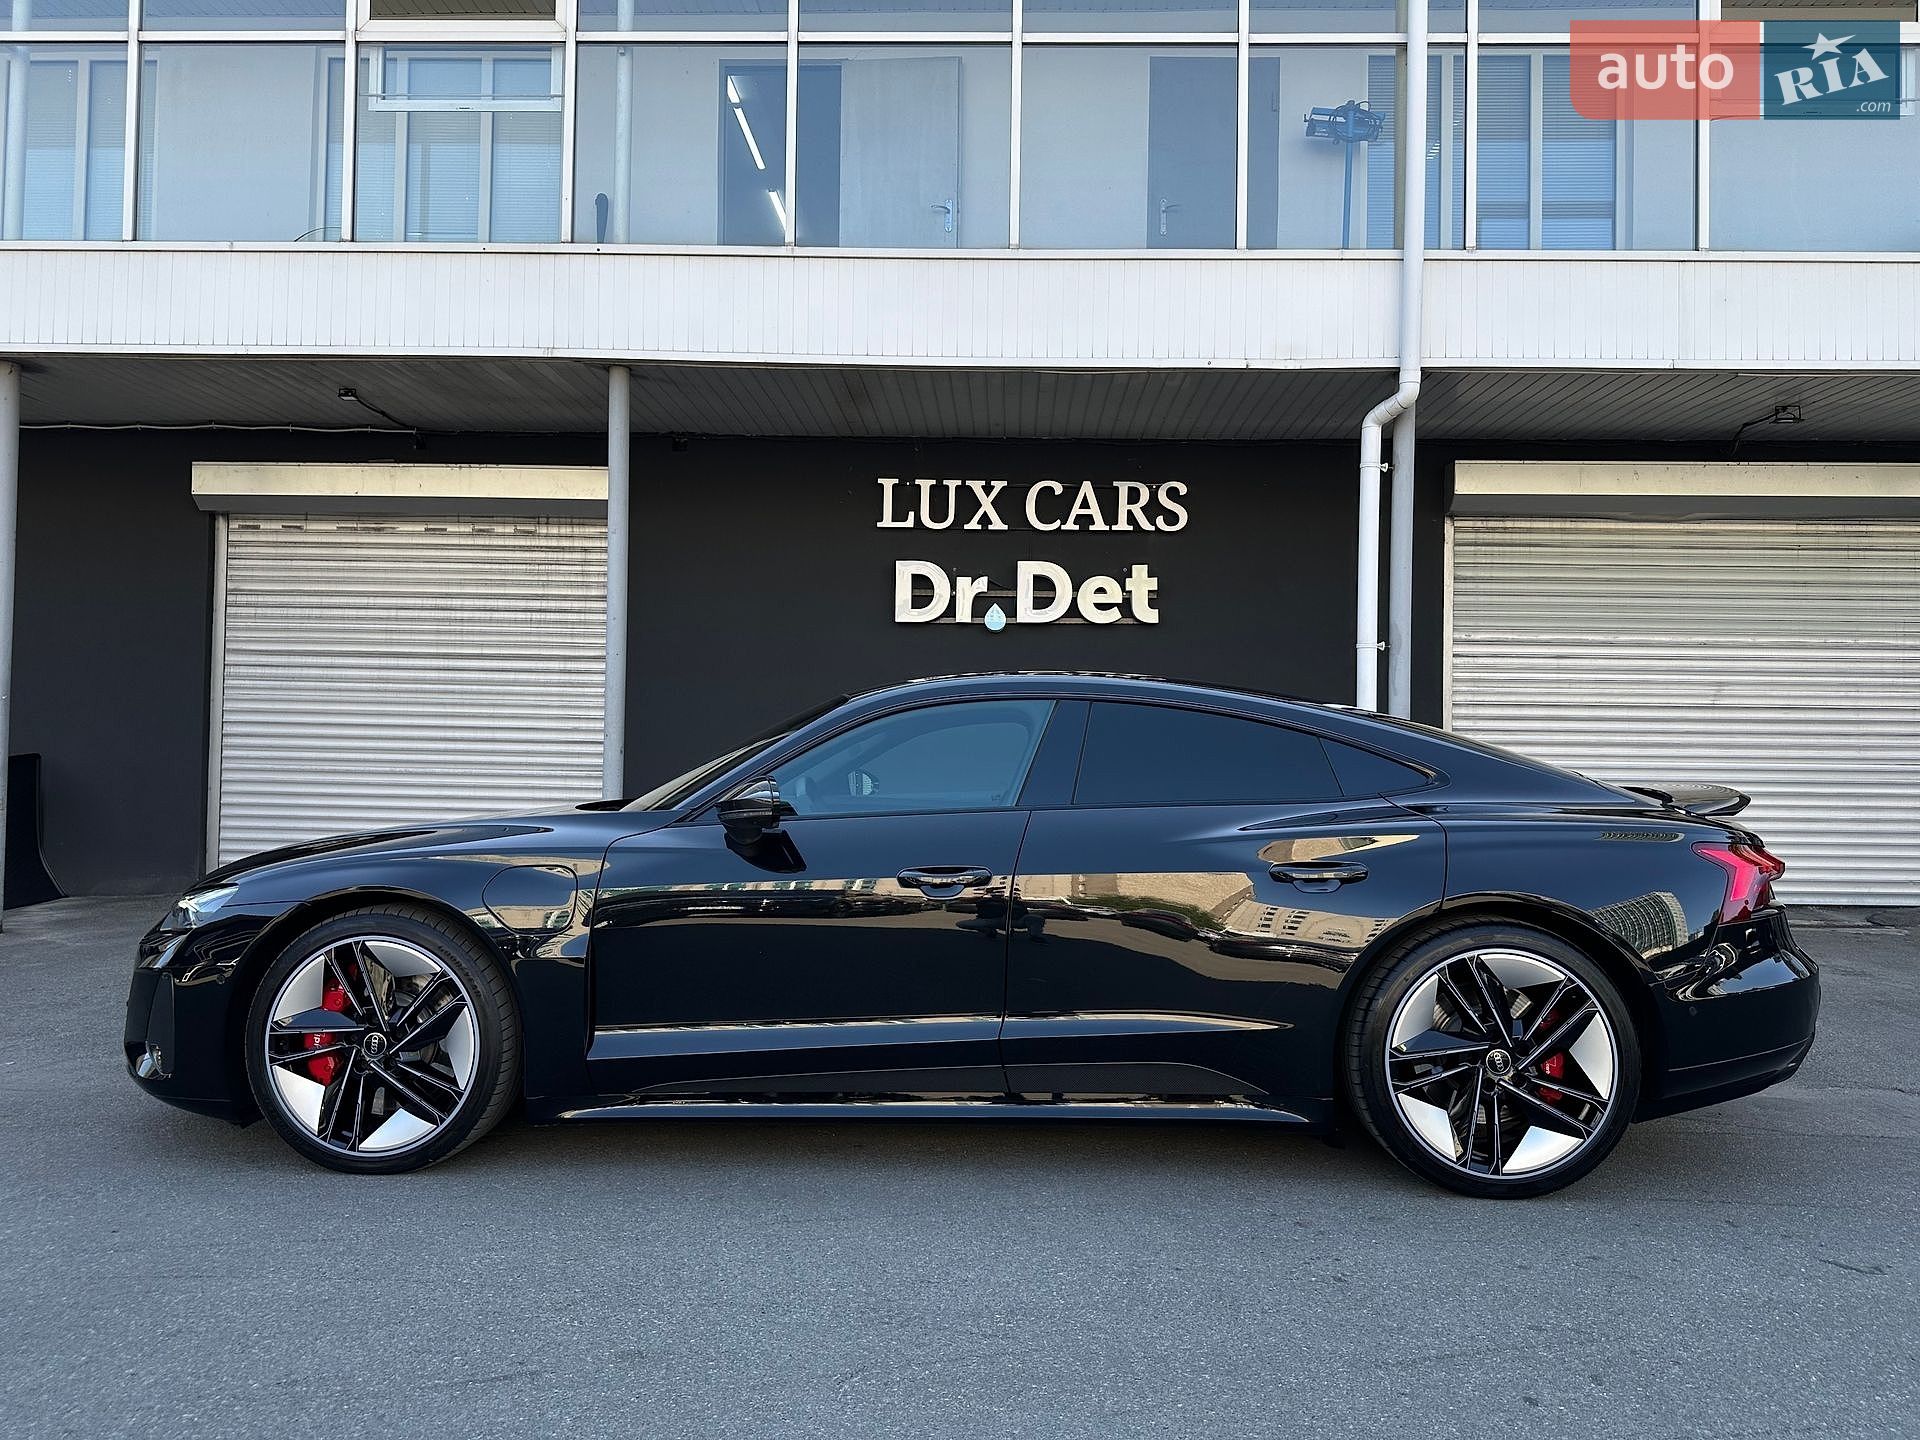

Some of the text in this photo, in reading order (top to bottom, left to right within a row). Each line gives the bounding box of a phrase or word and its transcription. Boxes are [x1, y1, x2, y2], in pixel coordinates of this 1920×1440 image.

[876, 478, 1188, 531] LUX CARS
[1016, 561, 1159, 624] Det
